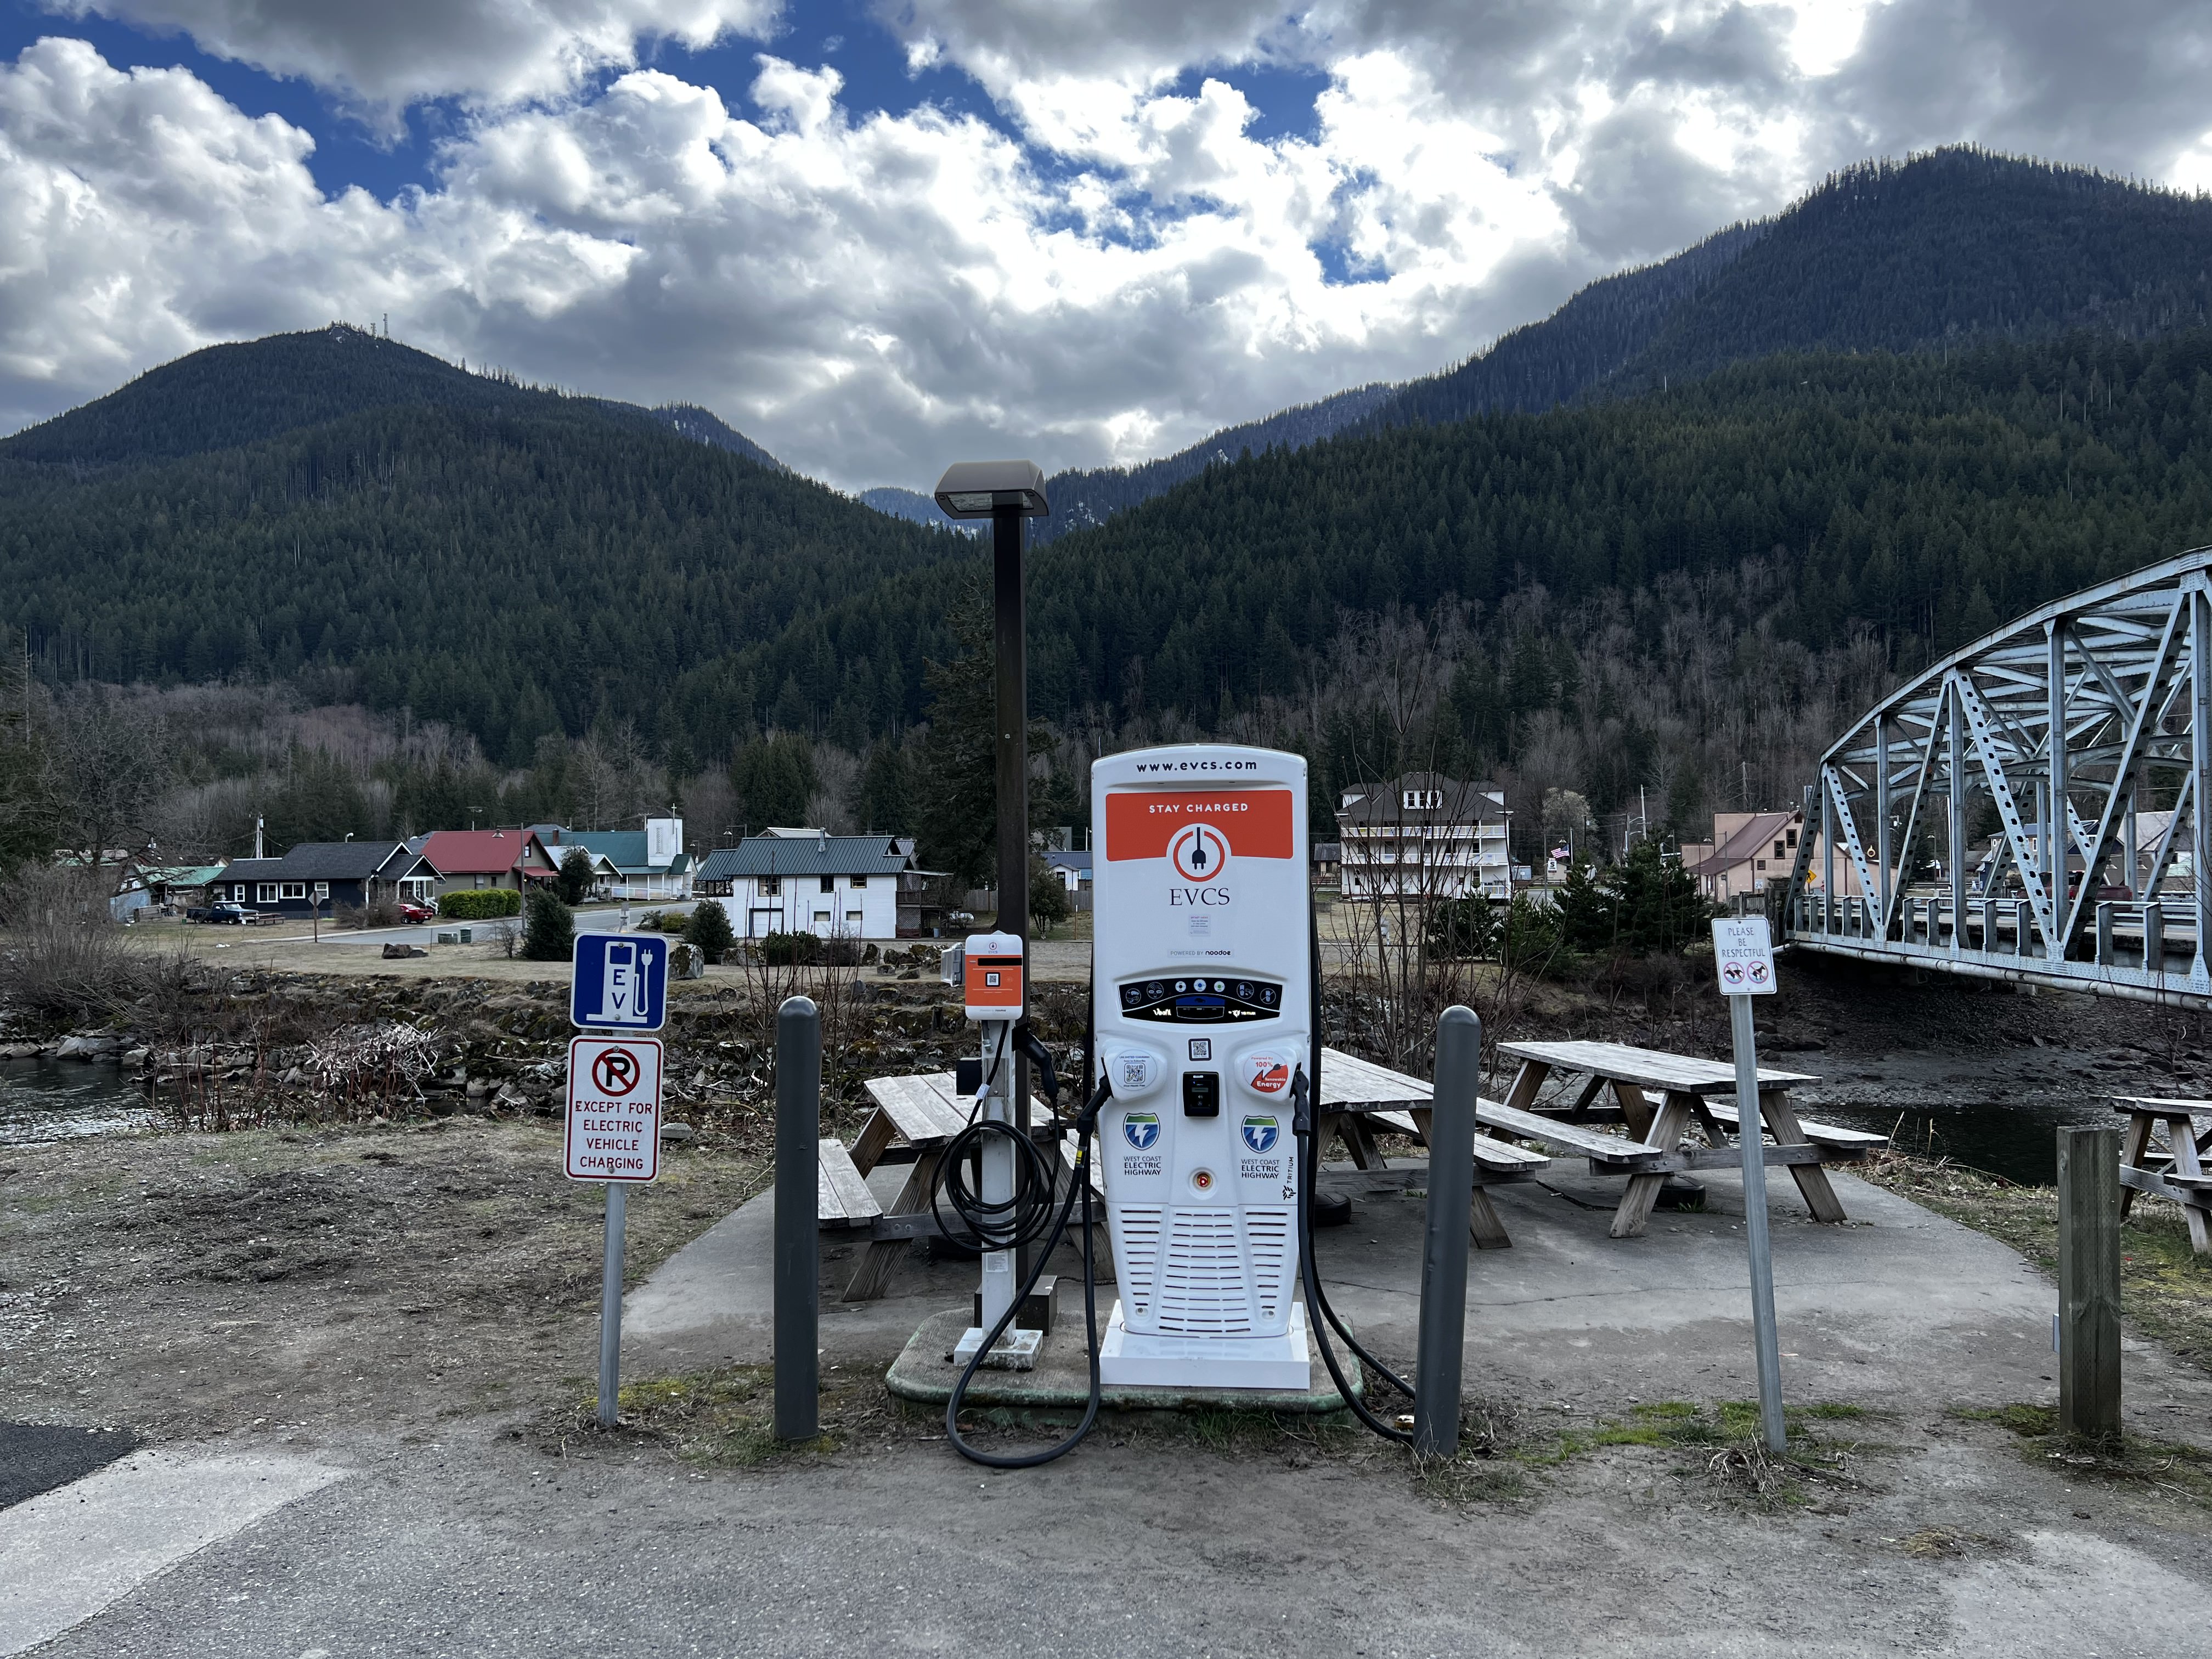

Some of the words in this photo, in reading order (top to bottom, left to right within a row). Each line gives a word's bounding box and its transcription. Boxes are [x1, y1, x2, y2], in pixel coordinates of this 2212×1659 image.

[1136, 761, 1257, 772] www.evcs.com
[1149, 804, 1180, 814] STAY
[1186, 803, 1248, 812] CHARGED
[1169, 888, 1230, 906] EVCS
[1728, 927, 1754, 936] PLEASE
[1738, 938, 1747, 946] BE
[1722, 949, 1765, 957] RESPECTFUL
[575, 1101, 622, 1113] EXCEPT
[629, 1103, 652, 1114] FOR
[584, 1120, 642, 1132] ELECTRIC
[586, 1138, 639, 1150] VEHICLE
[580, 1156, 643, 1169] CHARGING
